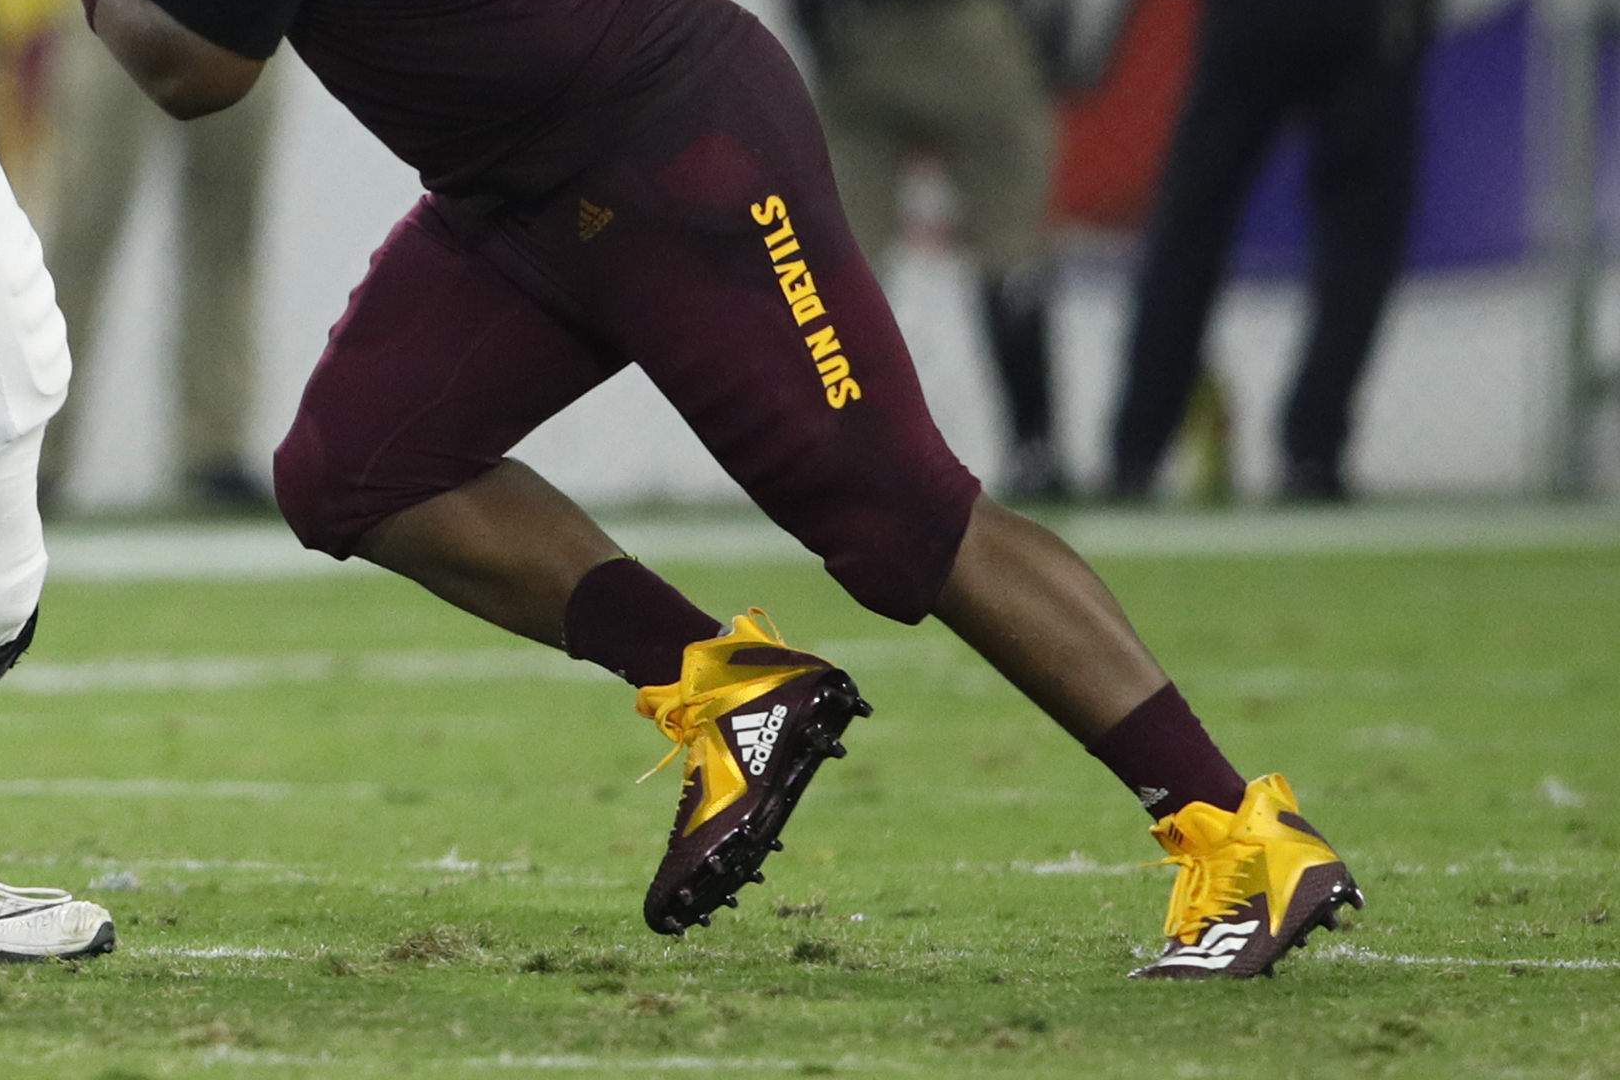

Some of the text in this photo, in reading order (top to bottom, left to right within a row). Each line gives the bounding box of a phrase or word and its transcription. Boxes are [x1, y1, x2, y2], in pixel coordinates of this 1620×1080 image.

[750, 194, 862, 410] SUN DEVILS
[749, 704, 788, 776] adidas
